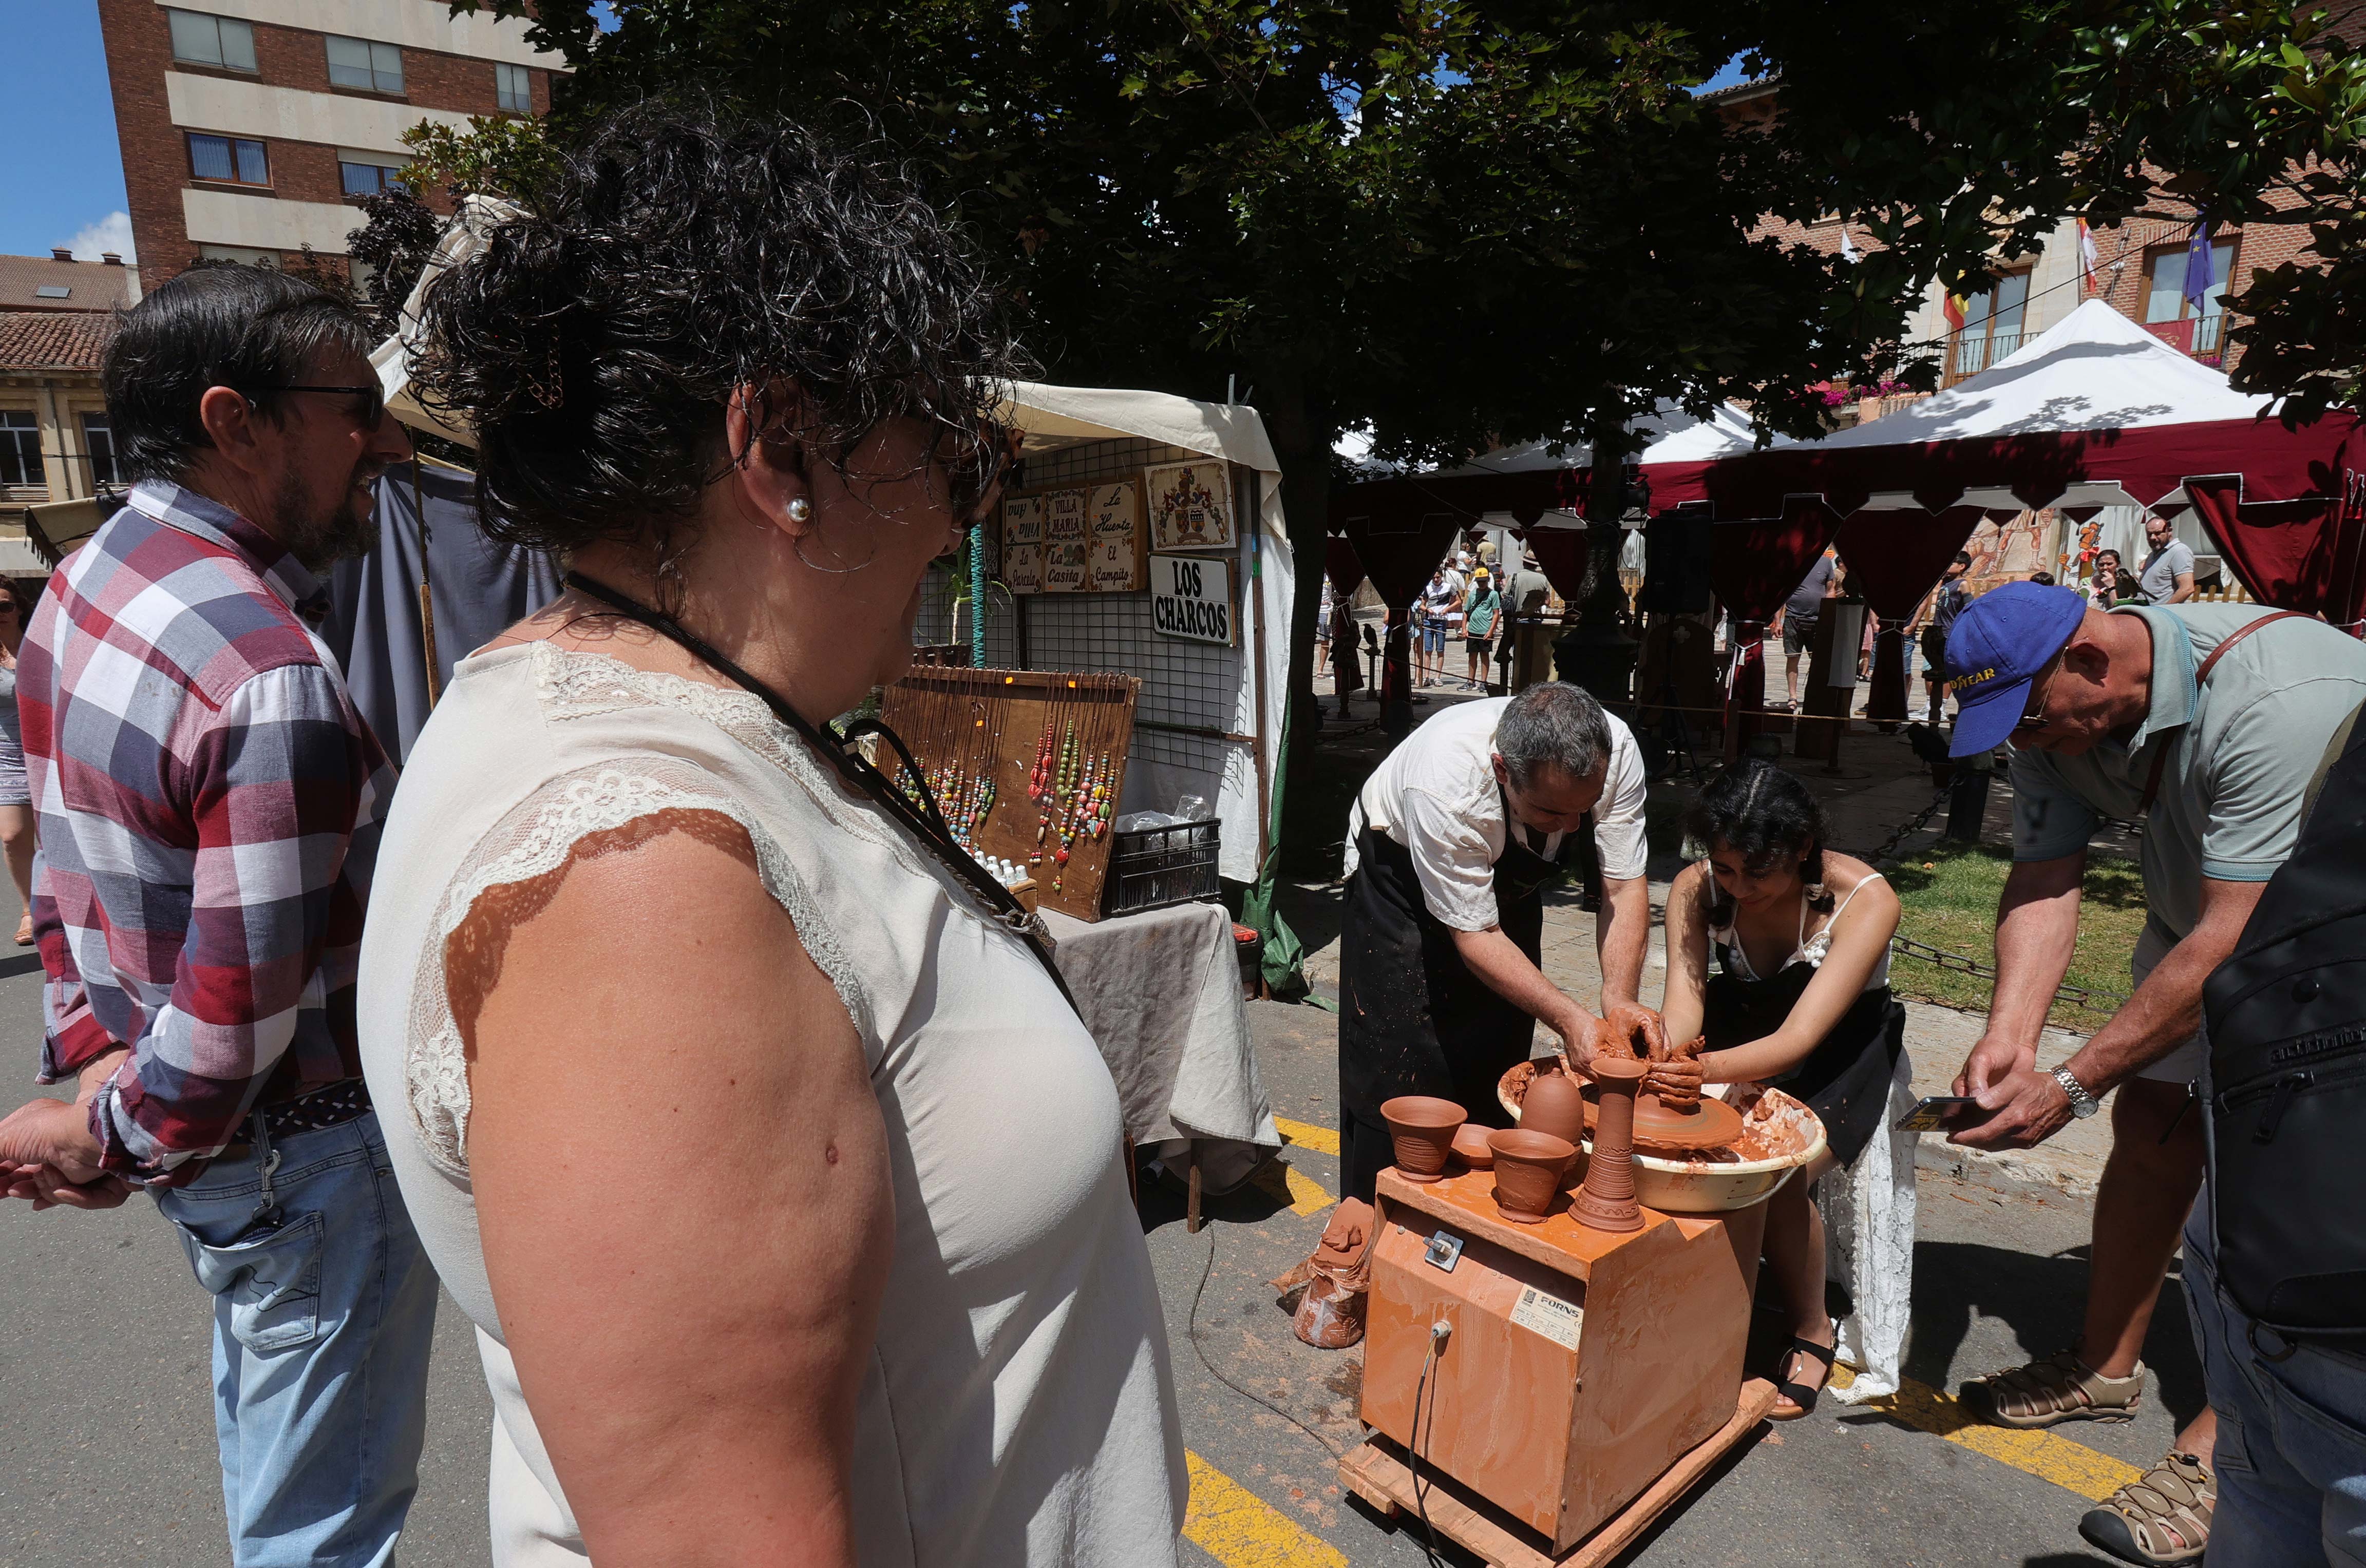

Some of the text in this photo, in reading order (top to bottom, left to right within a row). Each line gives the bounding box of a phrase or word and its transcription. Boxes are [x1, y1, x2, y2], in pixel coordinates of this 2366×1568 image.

[1103, 486, 1121, 507] La
[1007, 503, 1027, 519] Ana
[1055, 498, 1077, 514] VILLA
[1019, 521, 1040, 538] Villa
[1052, 517, 1080, 533] MARIA
[1095, 513, 1131, 532] Huerta
[1019, 548, 1028, 566] La
[1050, 551, 1064, 565] La
[1107, 545, 1116, 561] El
[1012, 568, 1035, 588] Parcela
[1048, 568, 1080, 583] Casita
[1095, 566, 1129, 585] Campito
[1172, 560, 1202, 598] LOS
[1155, 596, 1227, 641] CHARCOS
[1540, 1296, 1580, 1318] FORNS
